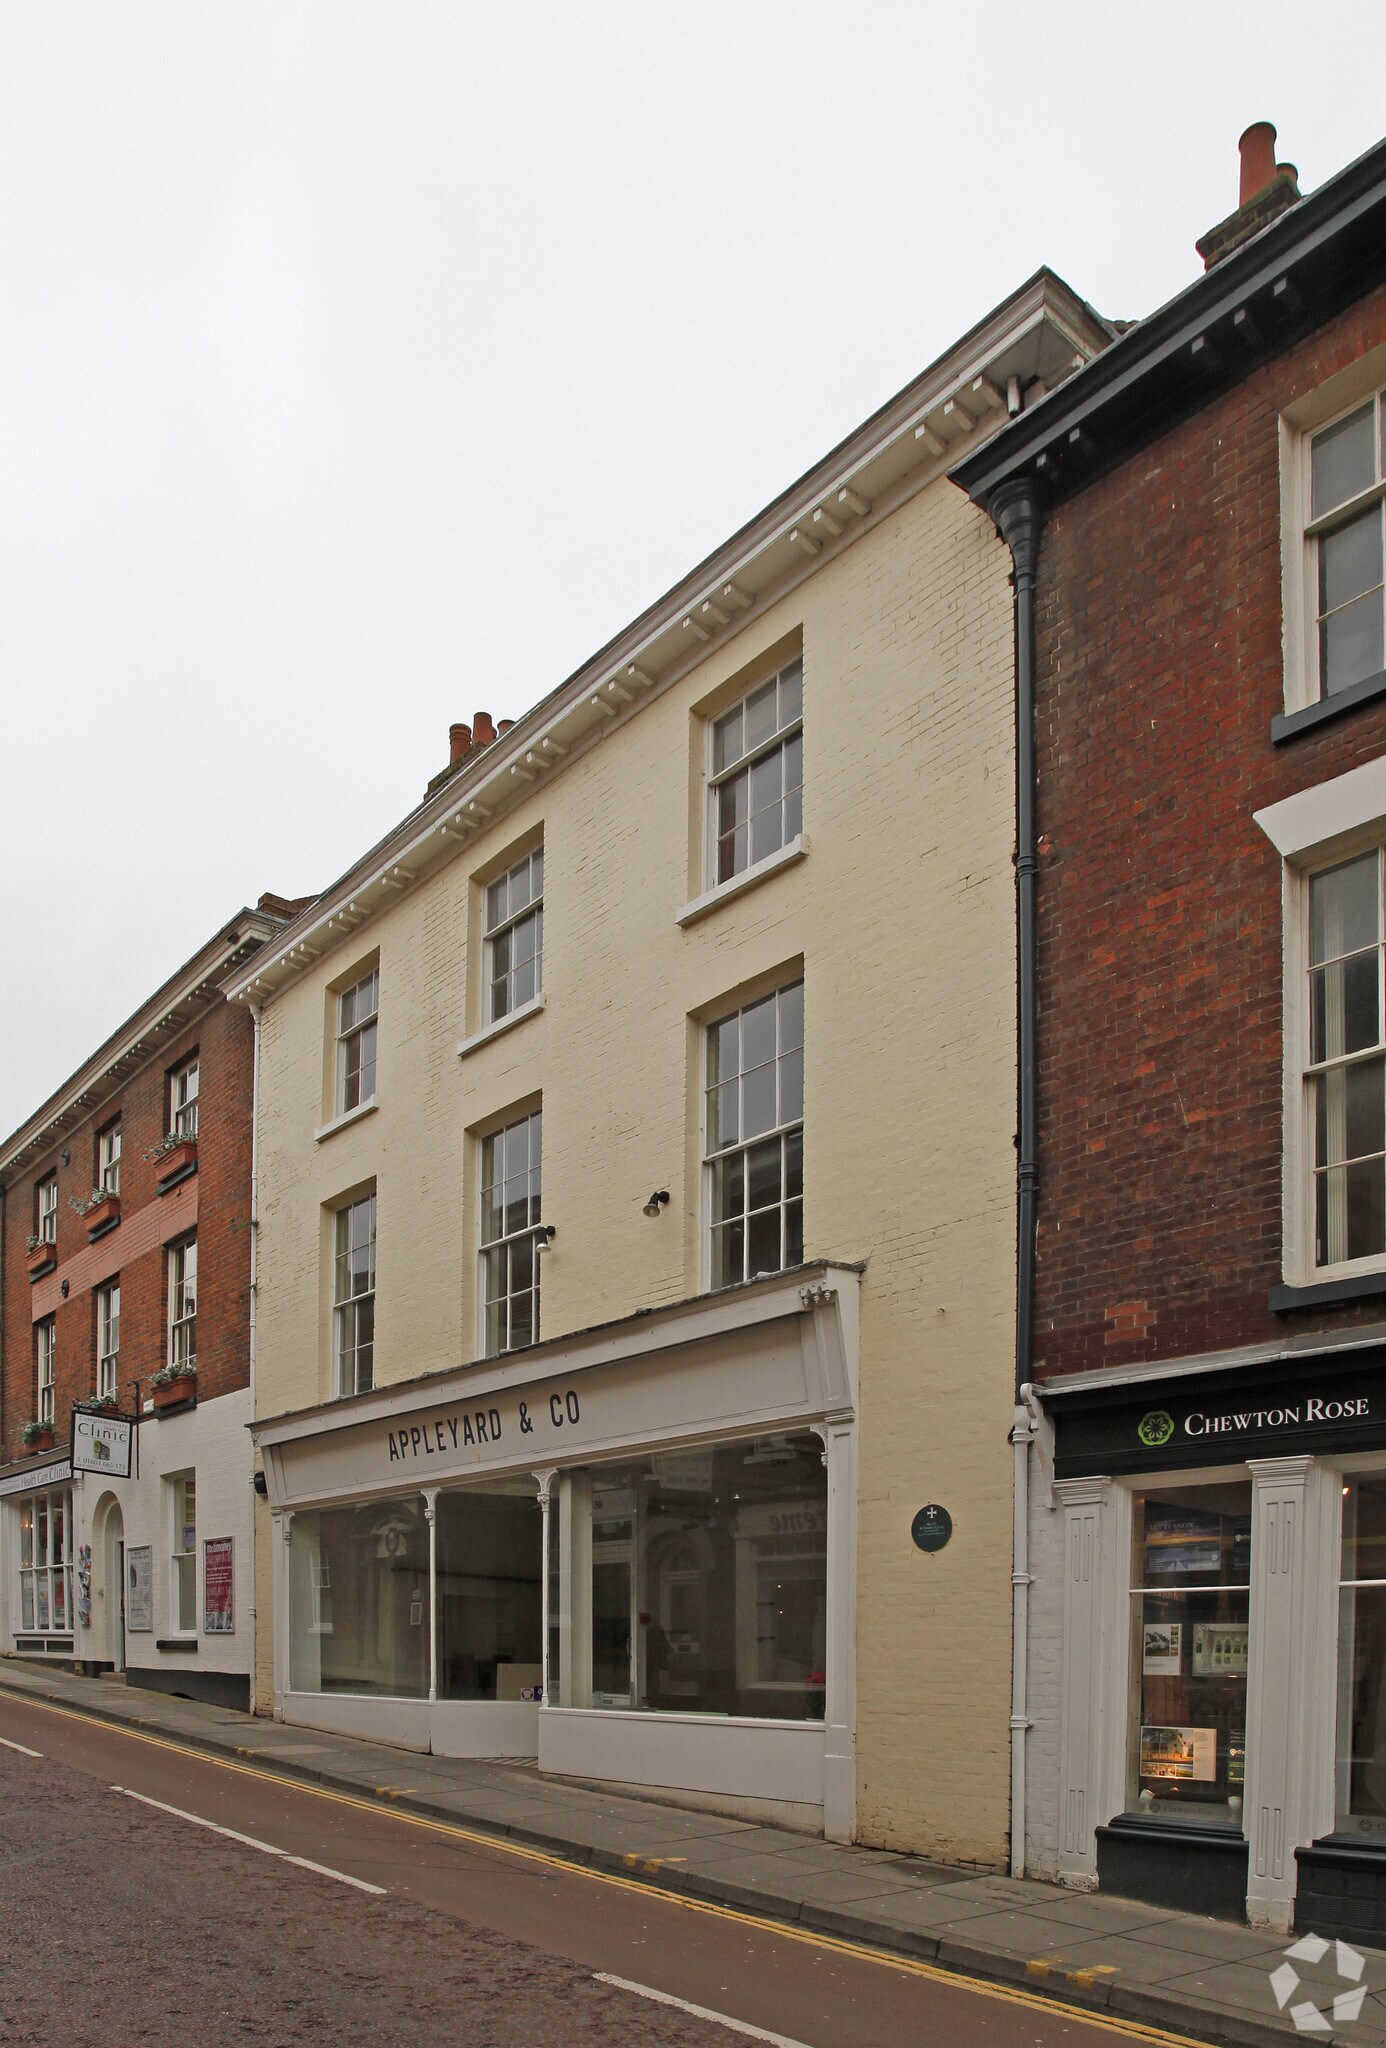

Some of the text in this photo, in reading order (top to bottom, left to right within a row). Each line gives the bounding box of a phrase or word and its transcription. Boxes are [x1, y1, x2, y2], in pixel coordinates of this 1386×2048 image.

[79, 1415, 128, 1429] Complementary
[388, 1390, 580, 1462] APPLEYARD & CO
[1184, 1398, 1370, 1436] CHEWTON ROSE
[78, 1422, 127, 1443] Clinic
[49, 1465, 69, 1480] Clinic
